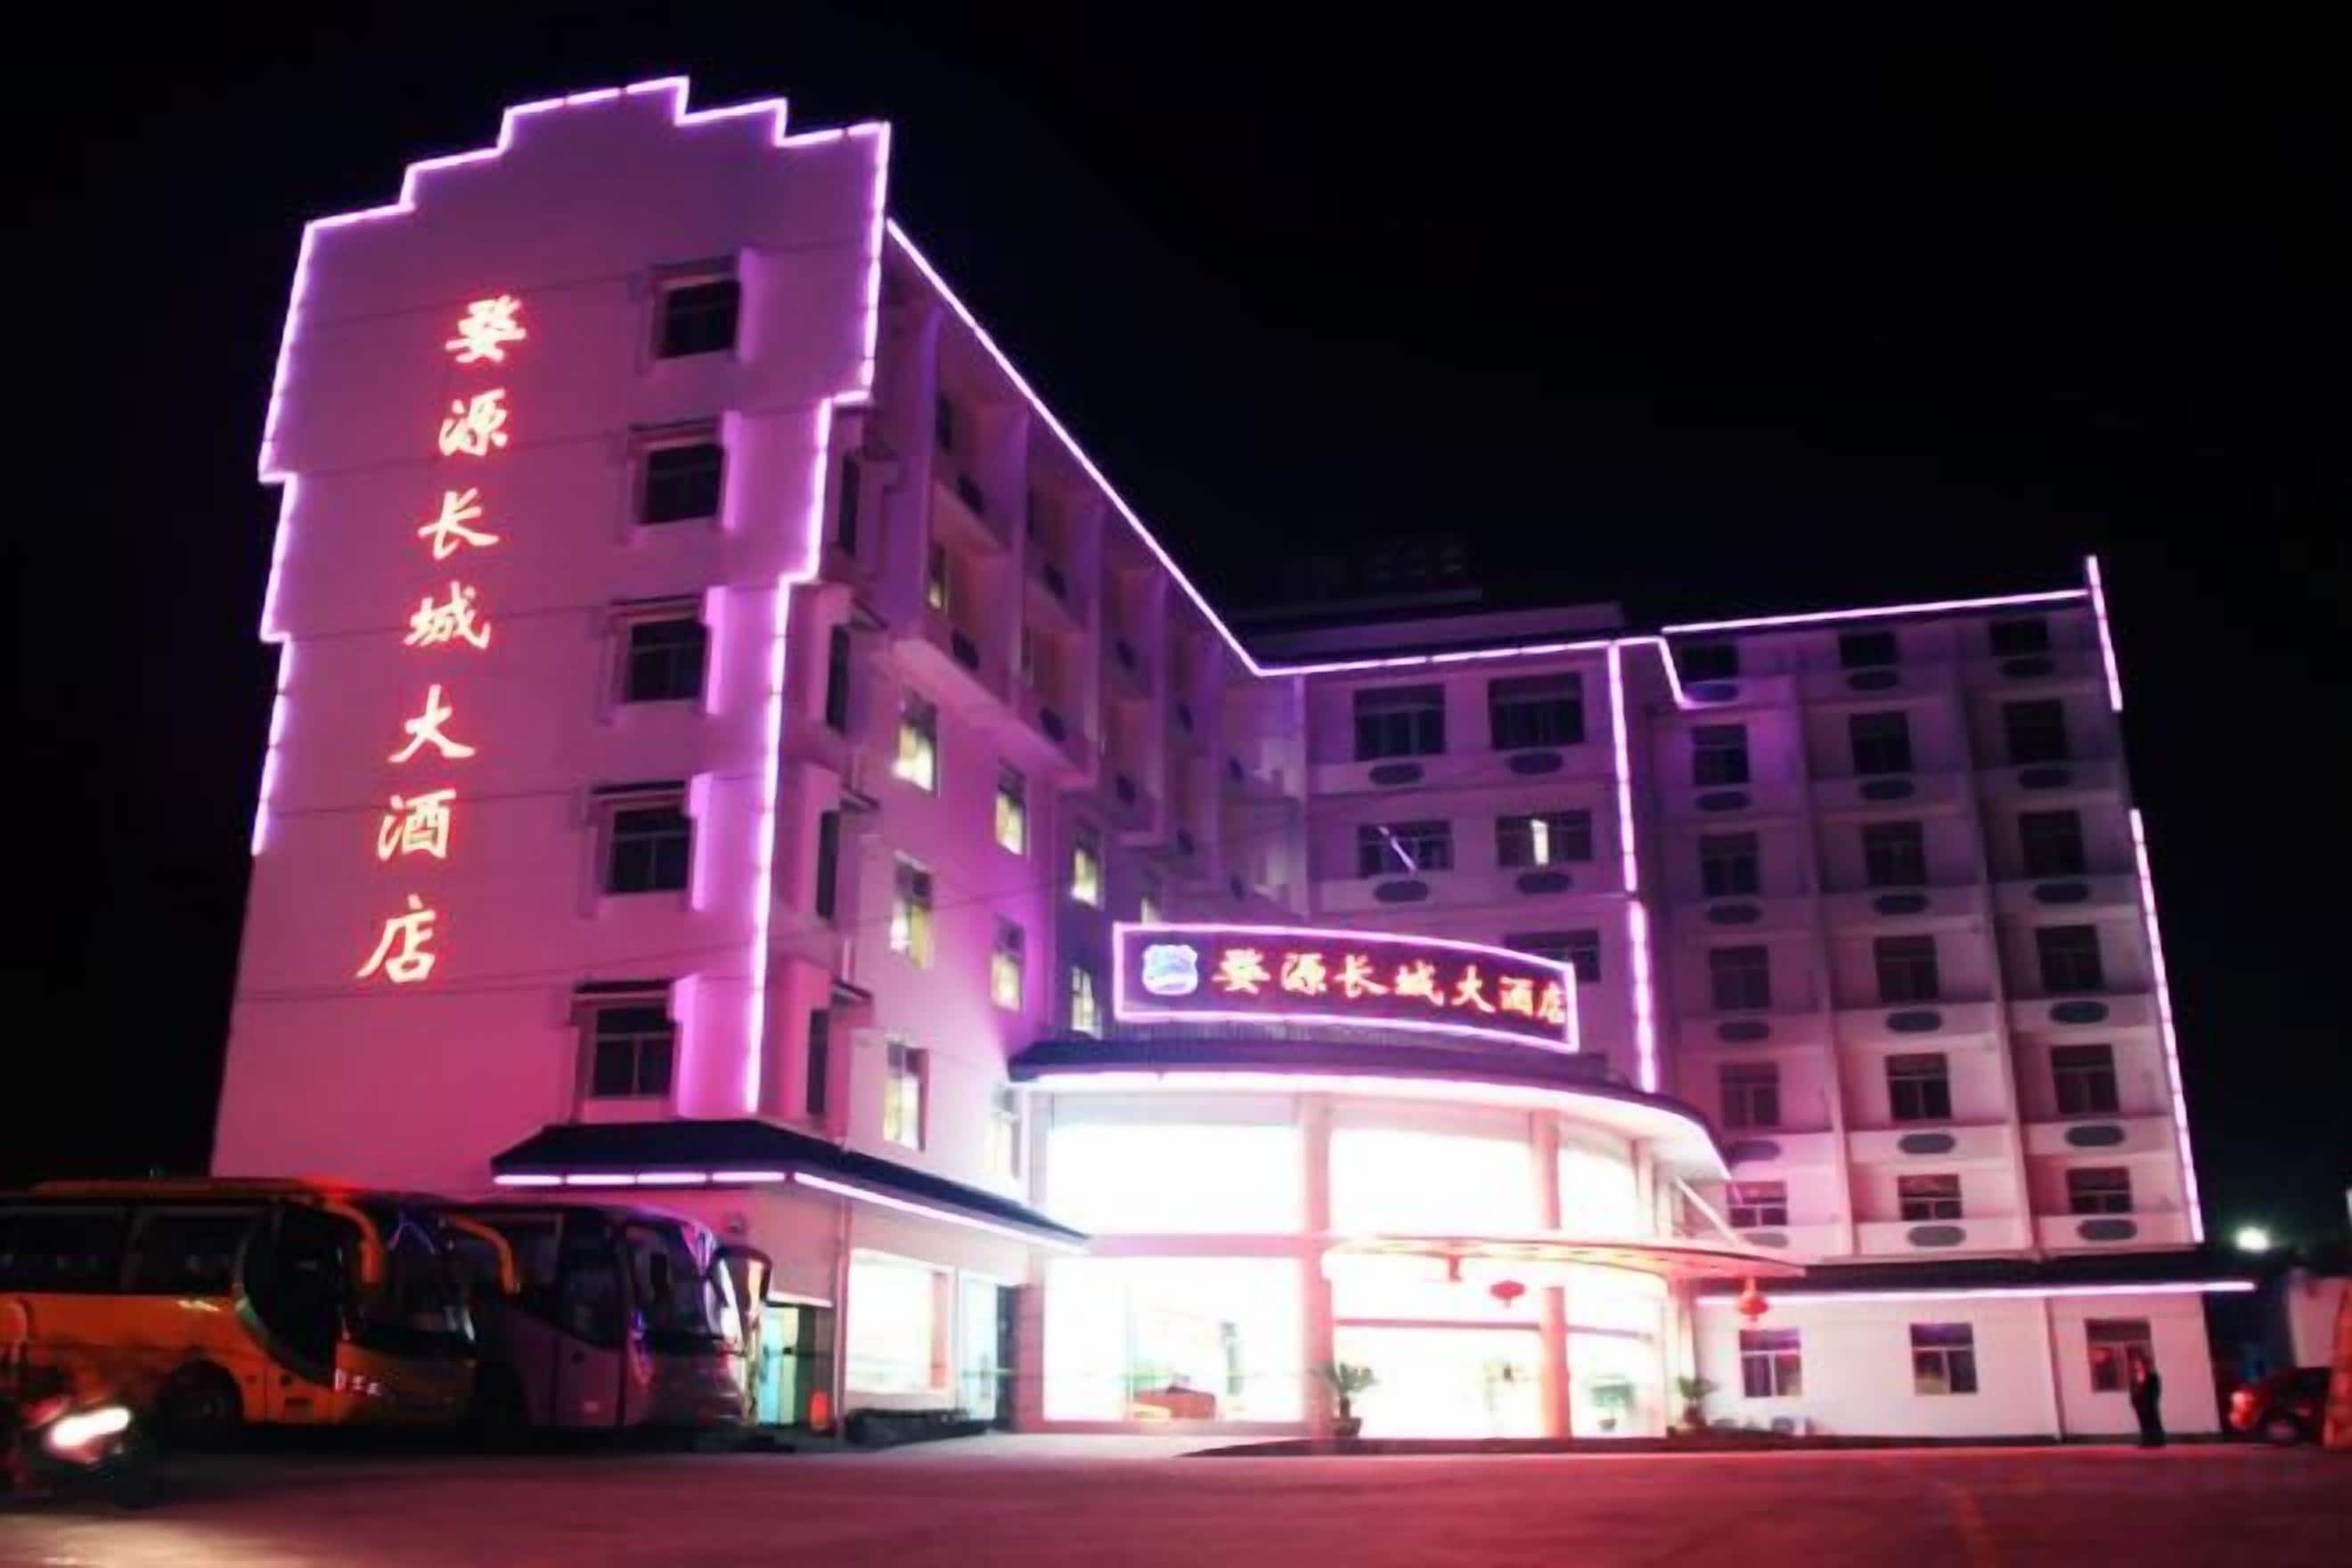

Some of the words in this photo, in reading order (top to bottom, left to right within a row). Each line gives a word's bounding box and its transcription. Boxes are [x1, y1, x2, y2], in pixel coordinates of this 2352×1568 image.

[355, 294, 527, 984] 婺源长城大酒店
[1212, 946, 1566, 1025] 婺源长城大酒店
